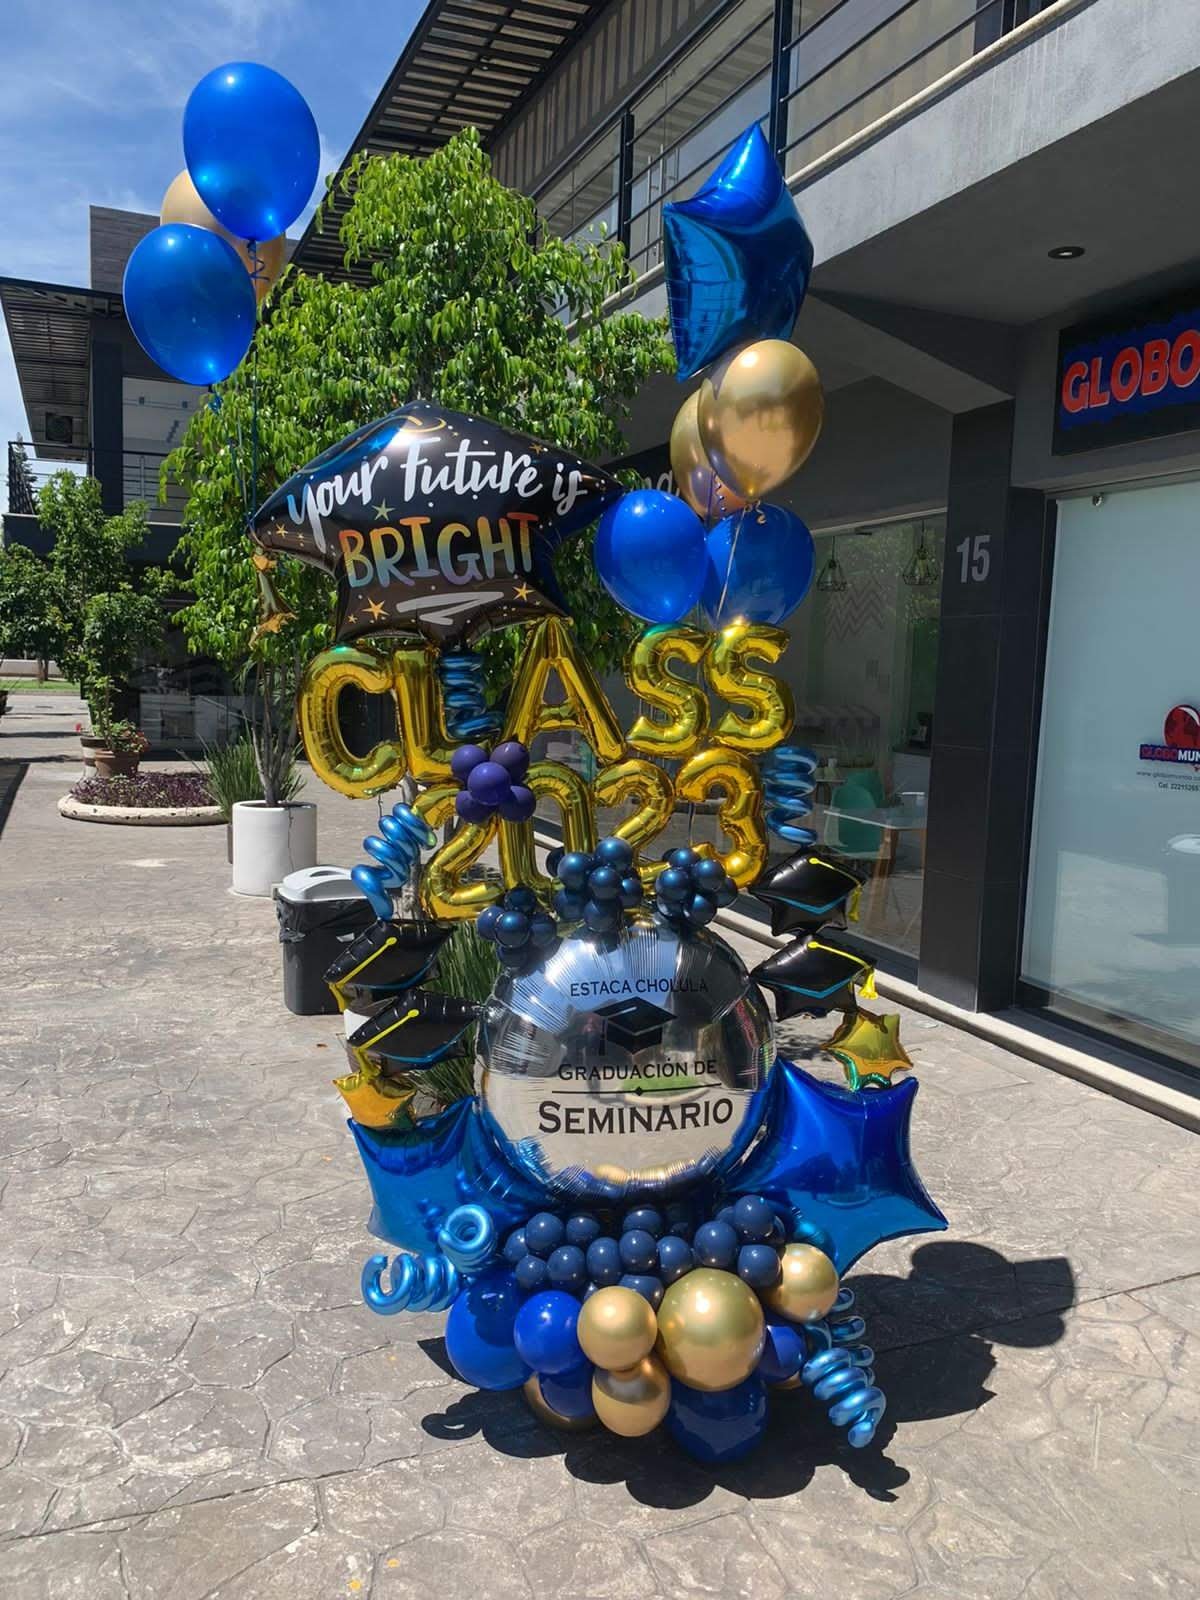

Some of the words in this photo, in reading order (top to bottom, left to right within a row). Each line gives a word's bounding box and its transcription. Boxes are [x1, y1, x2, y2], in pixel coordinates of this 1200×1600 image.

[1061, 329, 1200, 414] GLOBO
[400, 436, 543, 502] Future
[552, 462, 588, 515] is
[338, 512, 539, 588] BRIGHT
[956, 535, 991, 584] 15
[299, 617, 795, 799] CLASS
[570, 979, 633, 997] ESTACA
[635, 977, 709, 994] CHOLULA
[558, 1057, 689, 1081] GRADUACIÓN
[694, 1060, 718, 1076] DE
[538, 1098, 734, 1135] SEMINARIO
